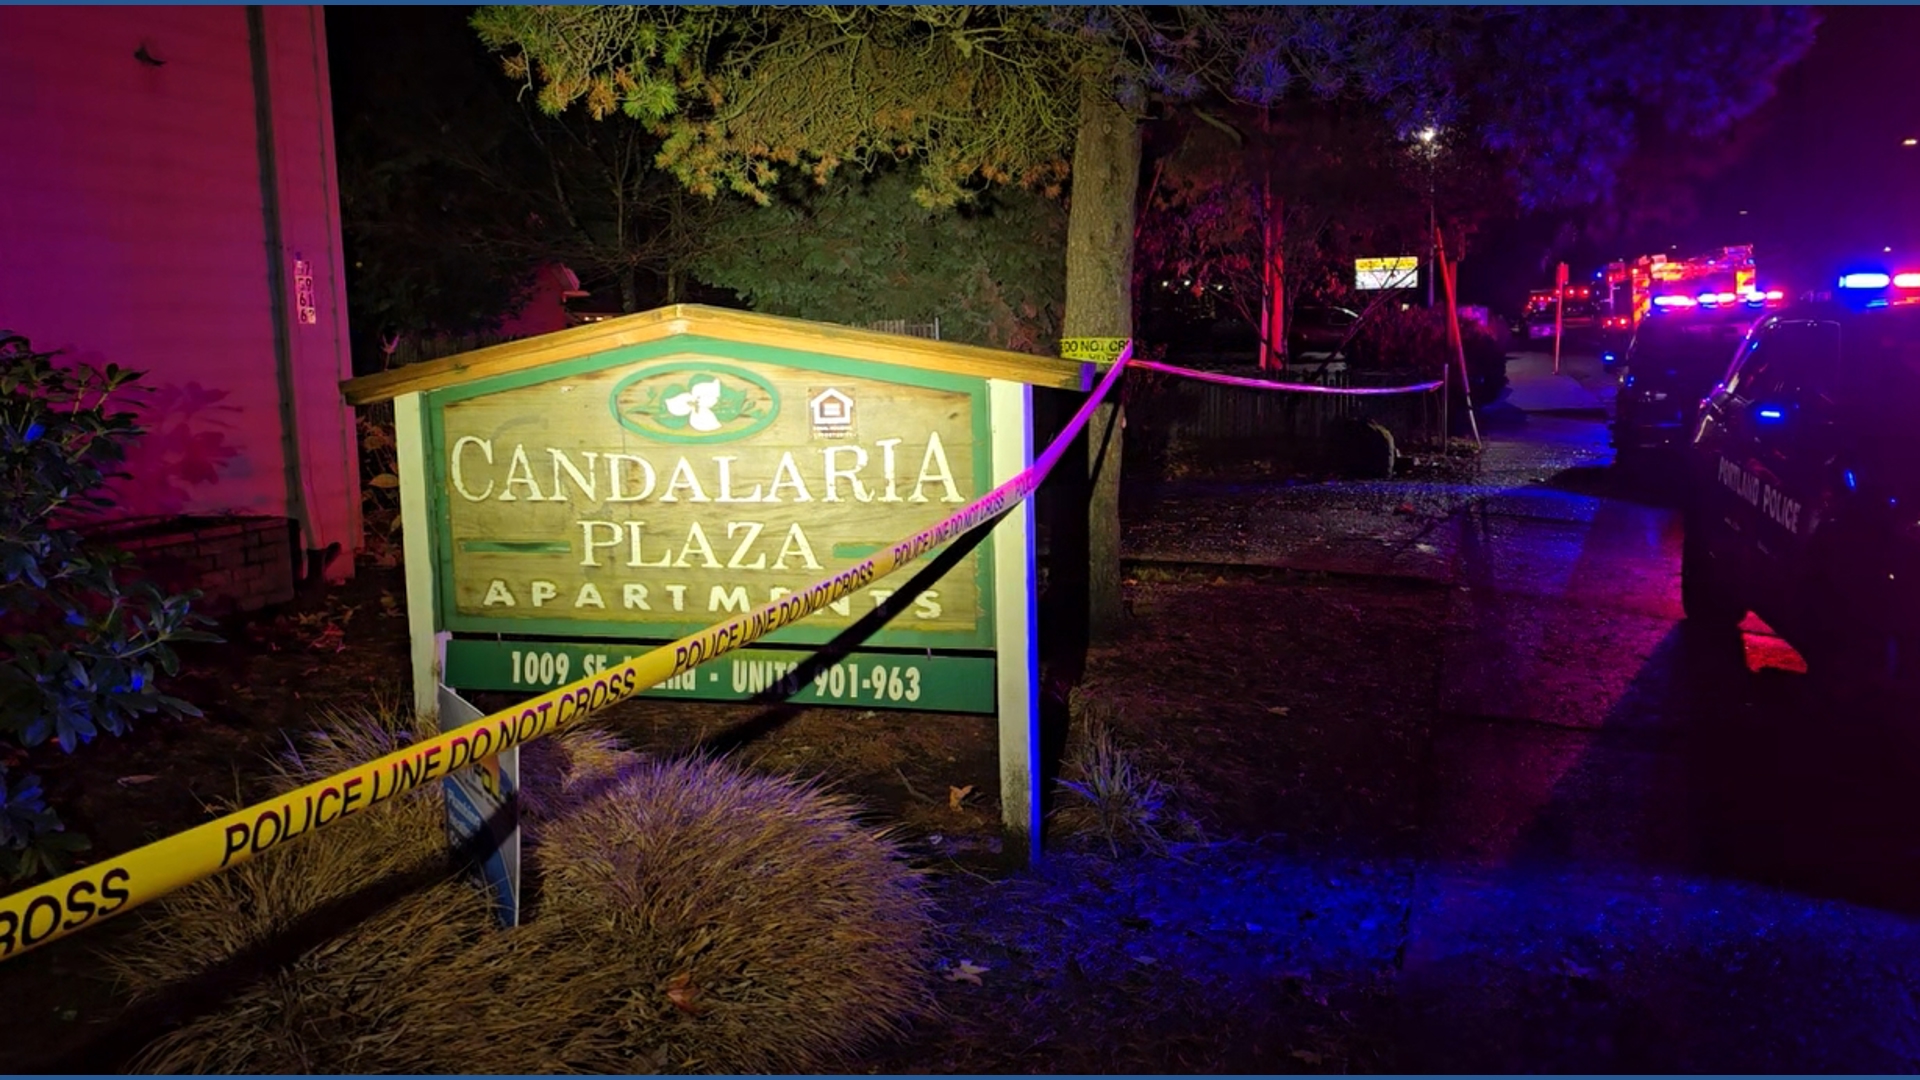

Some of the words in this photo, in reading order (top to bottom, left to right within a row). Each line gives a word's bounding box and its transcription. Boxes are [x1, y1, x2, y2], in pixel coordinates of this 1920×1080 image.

[451, 431, 966, 503] CANDALARIA
[892, 532, 929, 568] POLICE
[929, 521, 949, 549] LINE
[950, 515, 962, 538] DO
[963, 504, 979, 528] NOT
[980, 490, 1005, 521] CROSS
[1763, 484, 1801, 534] POLICE
[576, 521, 824, 570] PLAZA
[671, 624, 738, 677] POLICE
[739, 608, 775, 645] LINE
[776, 597, 800, 628] DO
[802, 581, 830, 616] NOT
[831, 560, 874, 598] CROSS
[512, 651, 570, 685] 1009
[732, 660, 799, 695] UNITS
[814, 663, 920, 702] 901-963
[220, 777, 362, 867] POLICE
[368, 746, 441, 807] LINE
[448, 728, 491, 772] DO
[497, 702, 553, 749] NOT
[555, 668, 636, 727] CROSS
